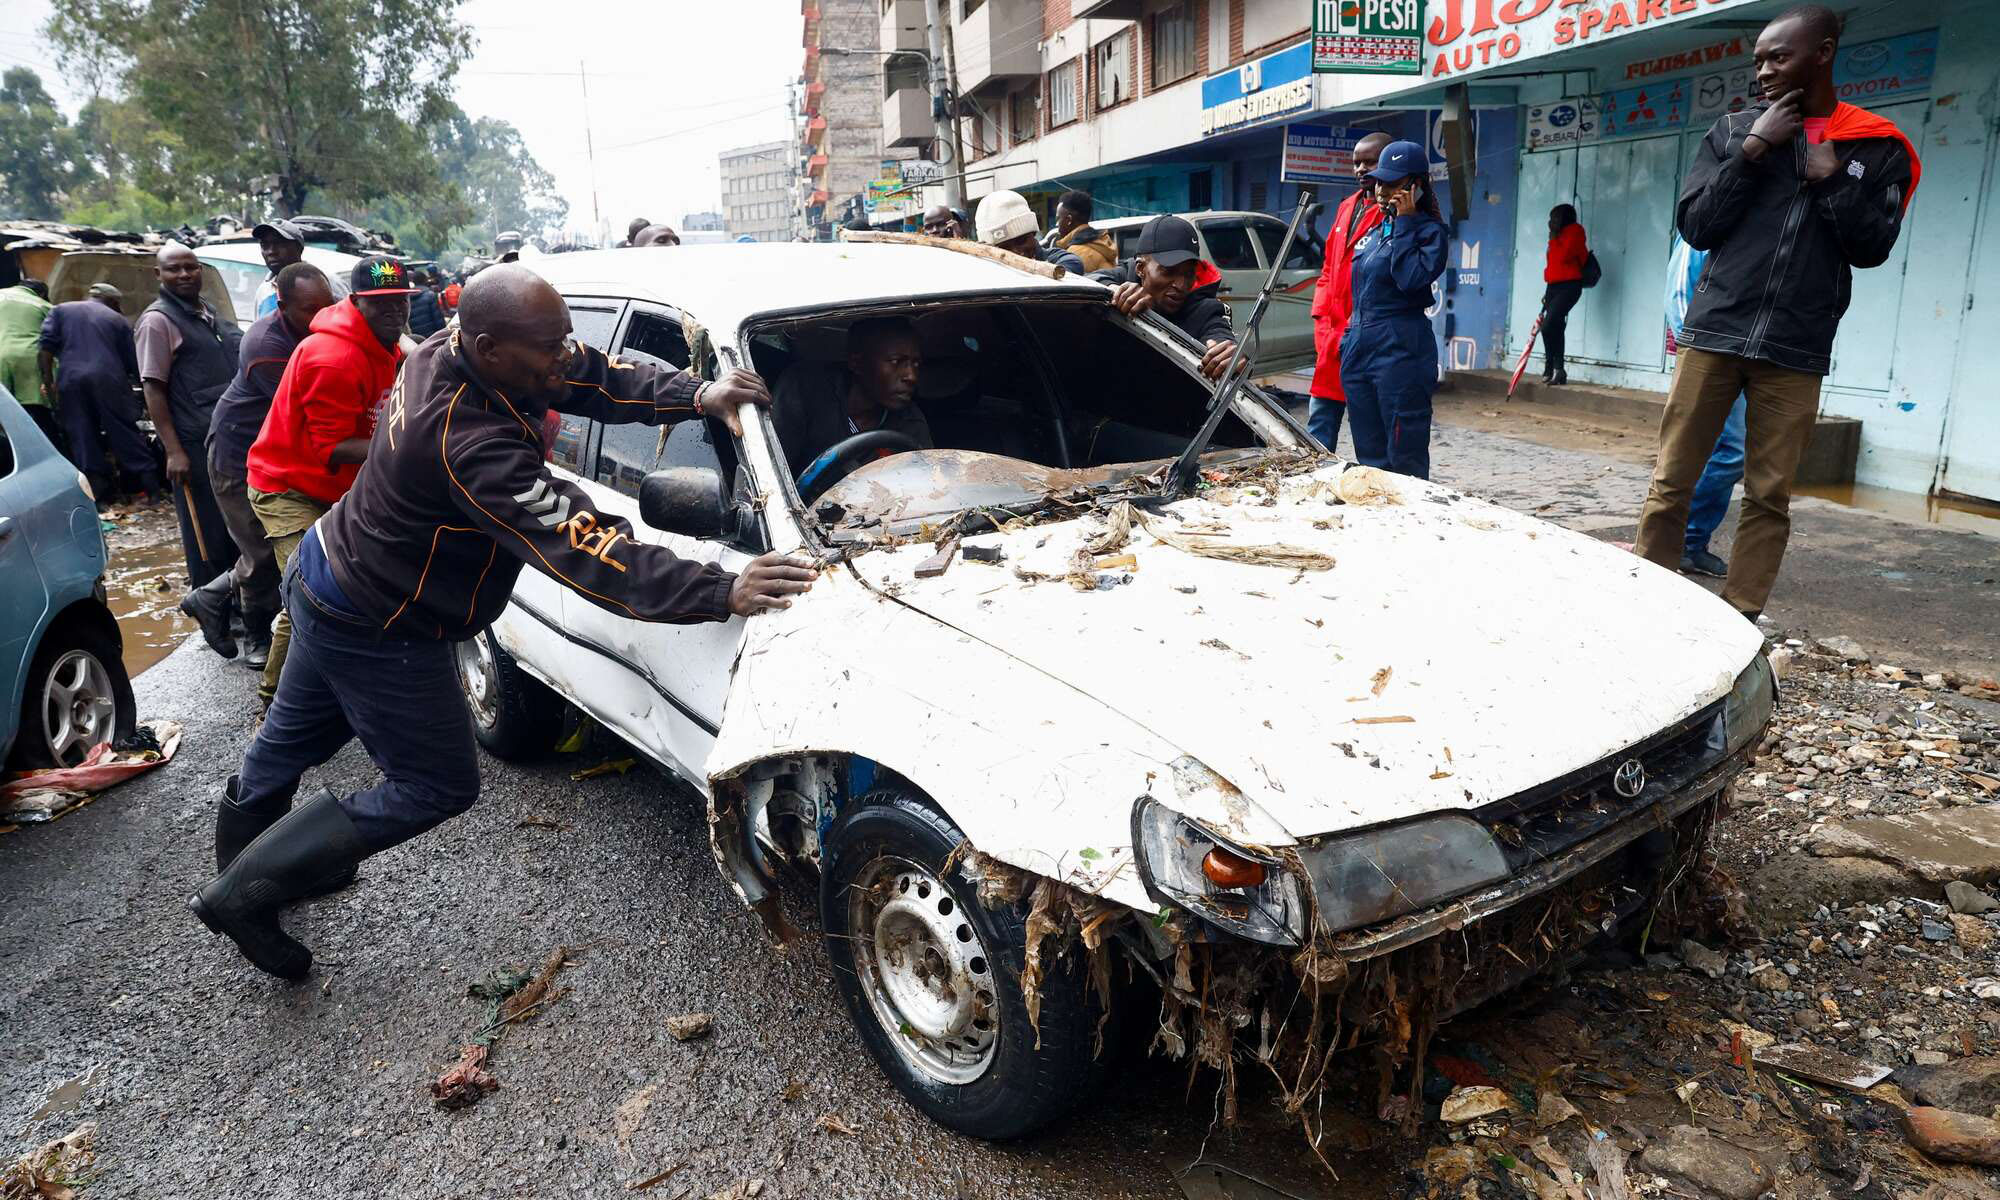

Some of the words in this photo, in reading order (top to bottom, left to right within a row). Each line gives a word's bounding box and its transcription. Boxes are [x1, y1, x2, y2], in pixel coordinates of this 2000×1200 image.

[1364, 0, 1418, 30] PESA
[1315, 47, 1361, 55] STORE
[1364, 49, 1418, 57] NUMBER
[1316, 35, 1361, 43] AGENT
[1365, 36, 1418, 46] NUMBER
[1432, 33, 1521, 77] AUTO
[1626, 38, 1742, 80] FUJISAWA
[1247, 76, 1312, 119] ENTERPRISES
